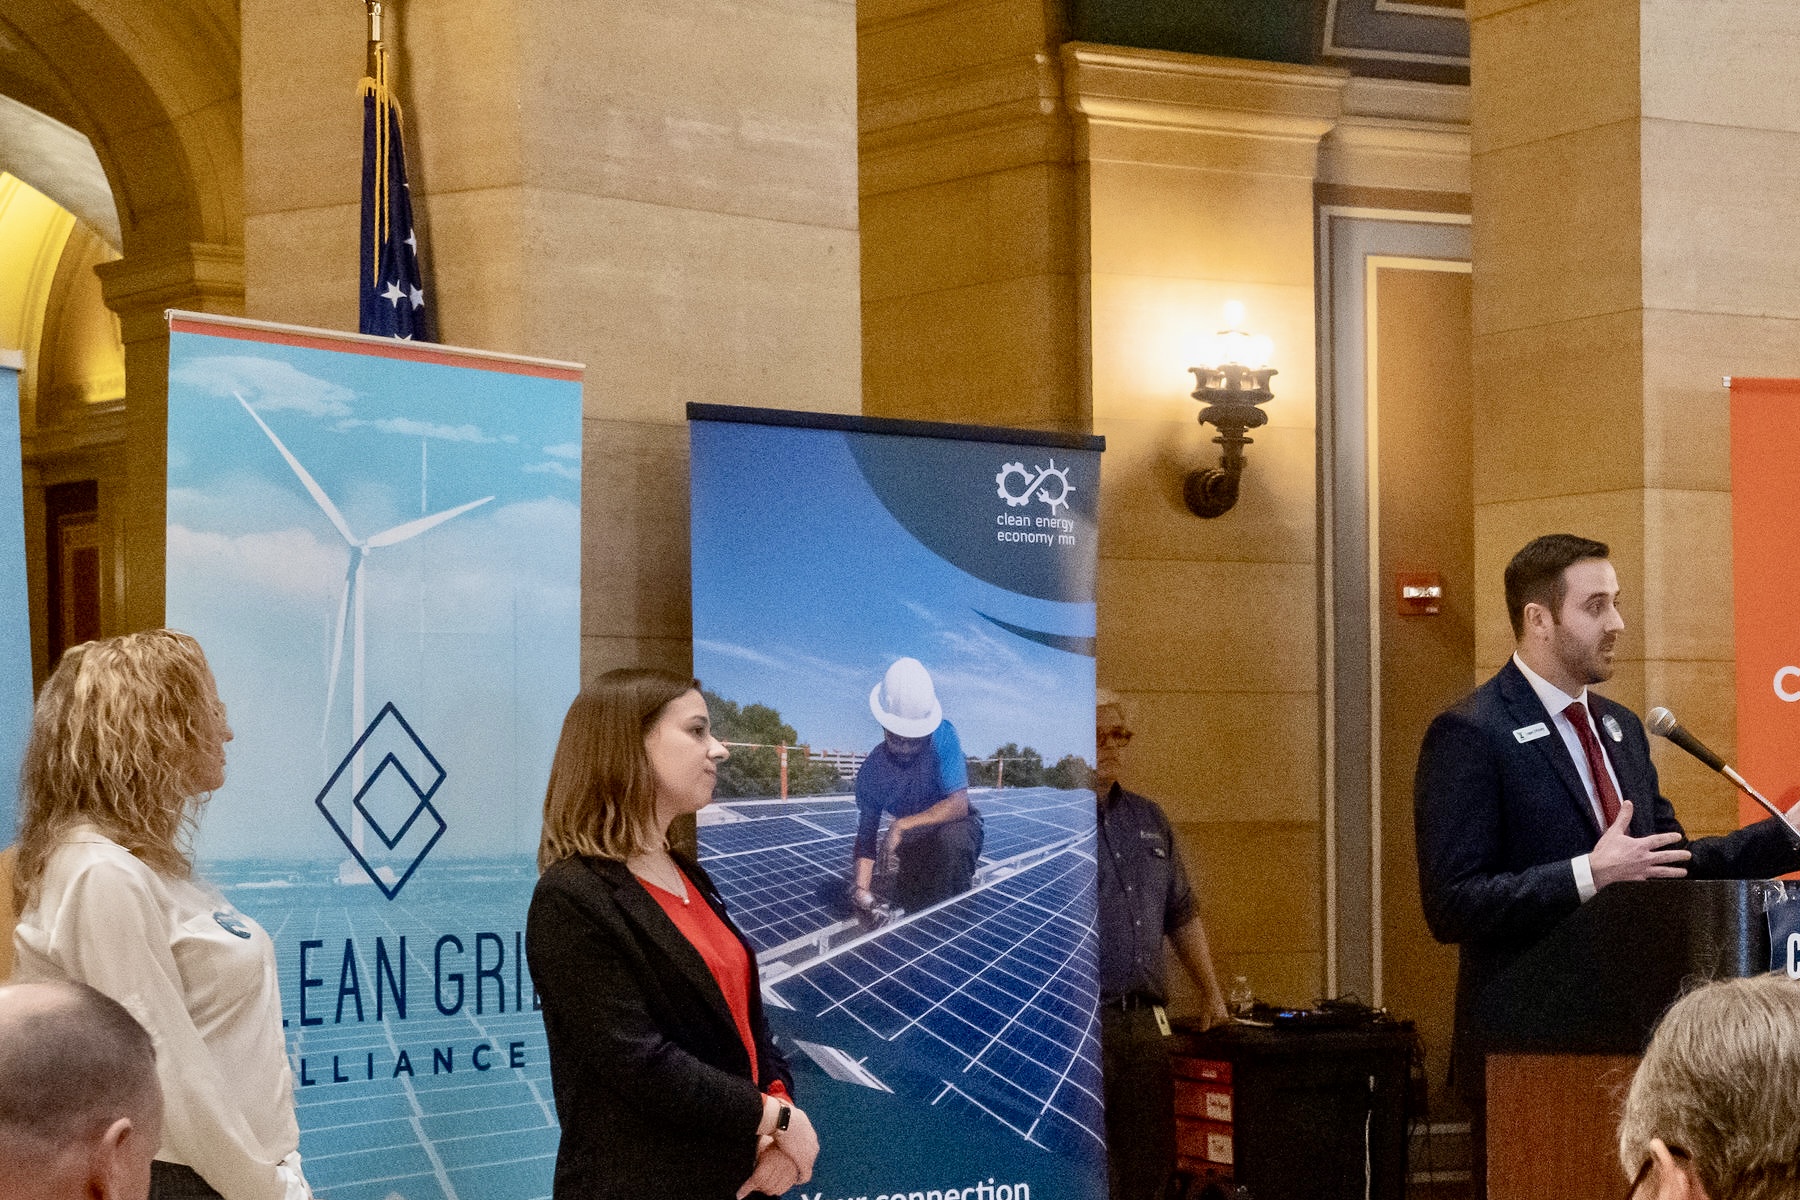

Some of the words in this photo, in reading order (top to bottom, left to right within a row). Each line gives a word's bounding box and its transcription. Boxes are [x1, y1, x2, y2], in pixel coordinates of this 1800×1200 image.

[996, 512, 1031, 527] clean
[1035, 517, 1074, 533] energy
[997, 531, 1054, 547] economy
[1058, 534, 1075, 546] mn
[283, 934, 407, 1028] EAN
[434, 931, 542, 1017] GRI
[300, 1041, 526, 1087] LLIANCE
